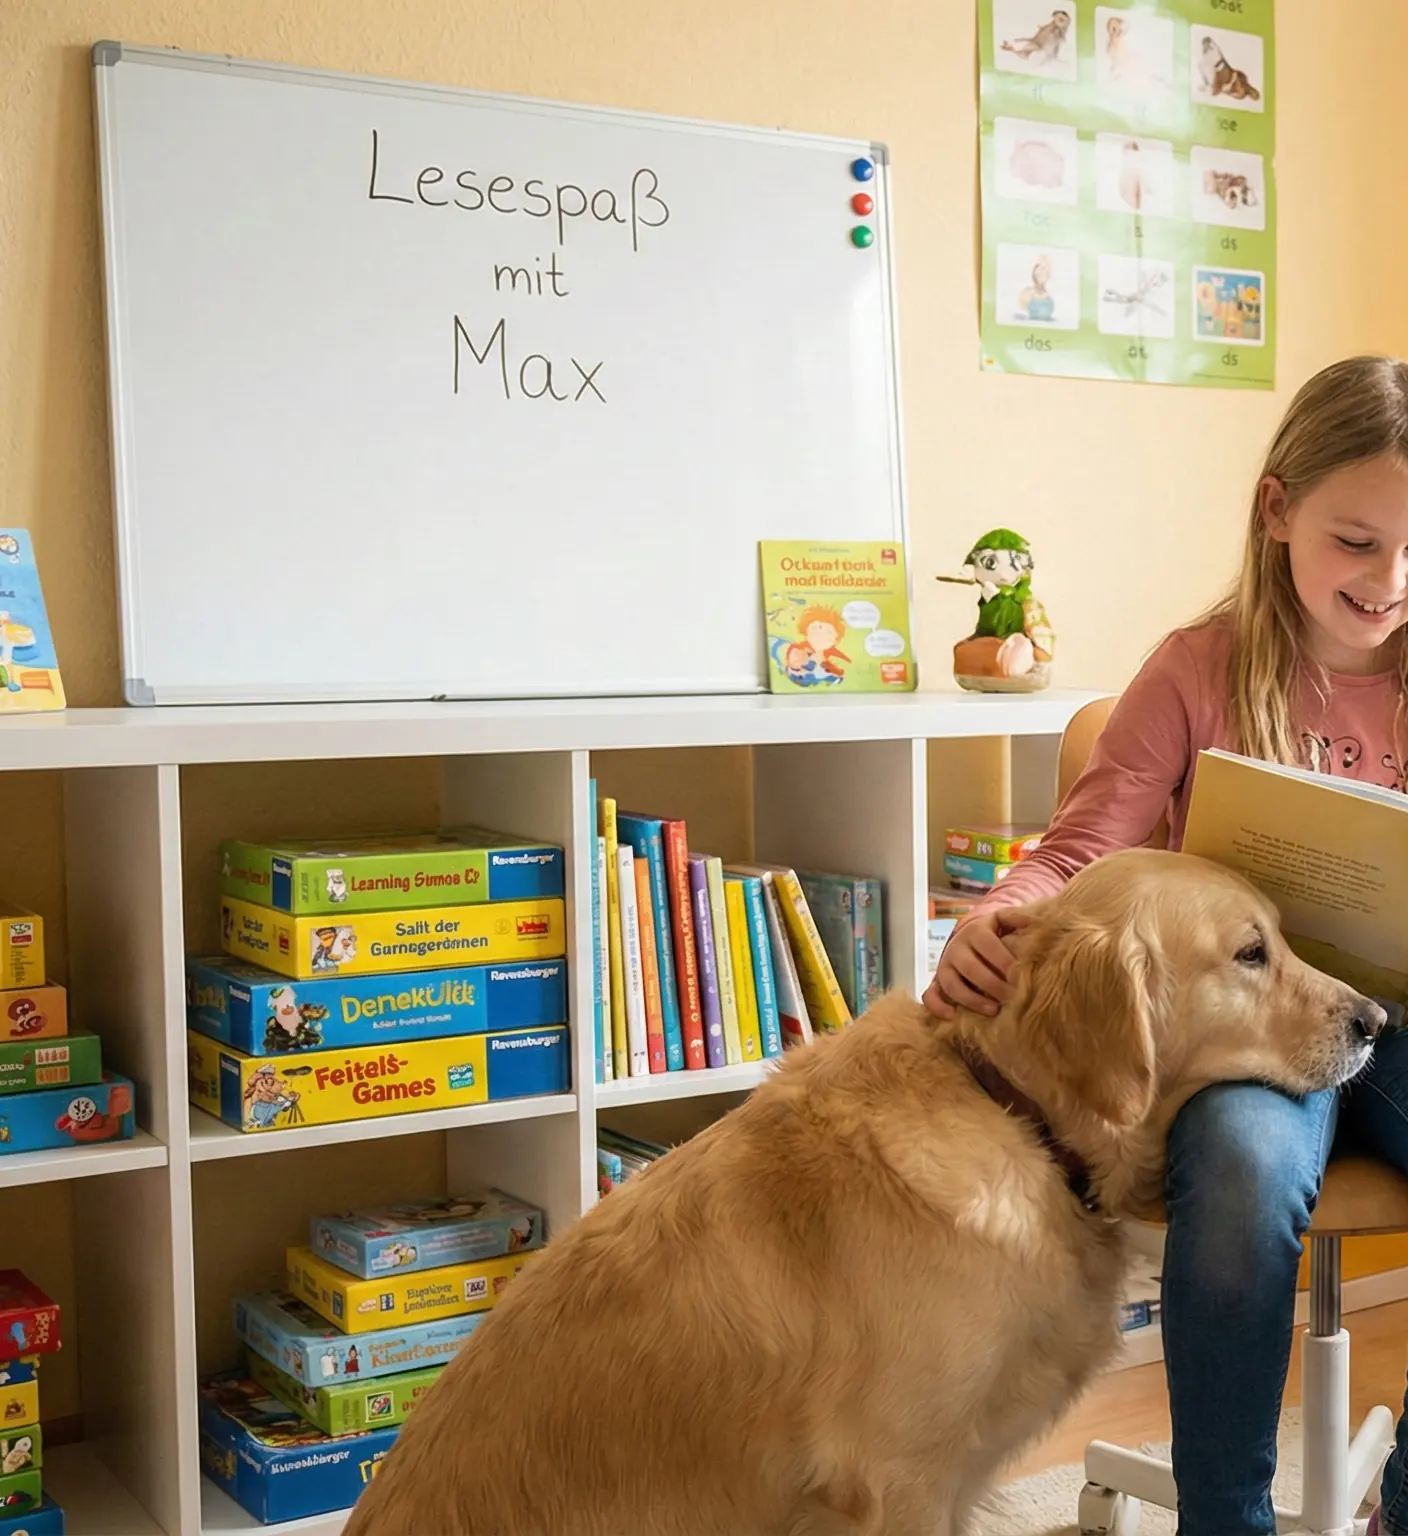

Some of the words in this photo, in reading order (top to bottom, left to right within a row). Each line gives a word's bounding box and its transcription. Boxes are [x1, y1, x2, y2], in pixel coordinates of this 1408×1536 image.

[369, 129, 669, 252] Lesespaß
[494, 252, 570, 297] mit
[453, 314, 607, 403] Max
[351, 873, 410, 892] Learning
[435, 918, 460, 933] der
[352, 1077, 436, 1104] Games
